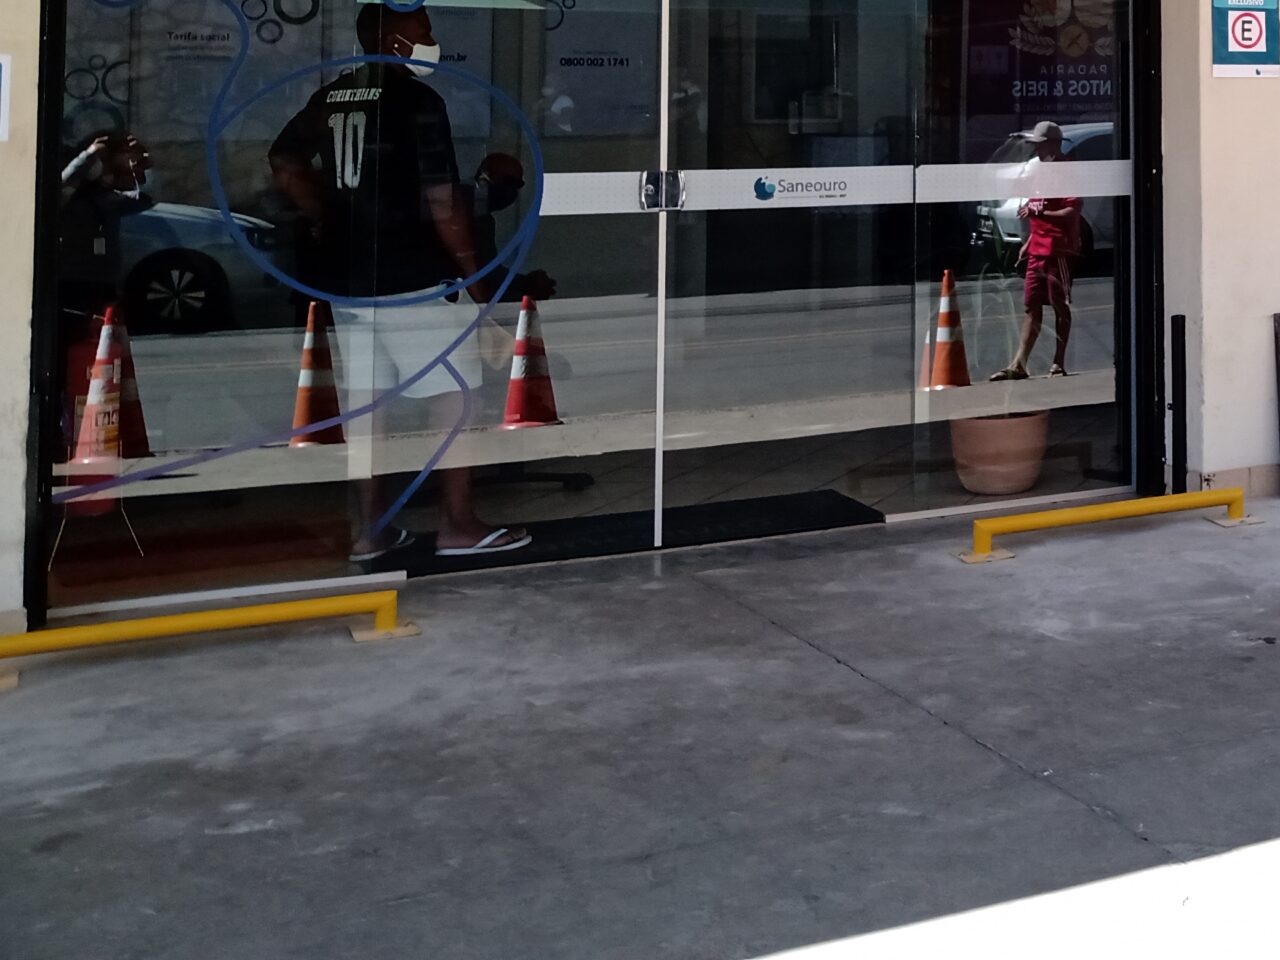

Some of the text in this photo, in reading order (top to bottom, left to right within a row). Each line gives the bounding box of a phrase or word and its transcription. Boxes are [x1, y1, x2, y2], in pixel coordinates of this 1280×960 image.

[1241, 20, 1253, 41] E
[560, 57, 585, 67] 0800
[586, 57, 605, 67] 002
[328, 111, 367, 190] 10
[778, 179, 847, 193] Saneouro
